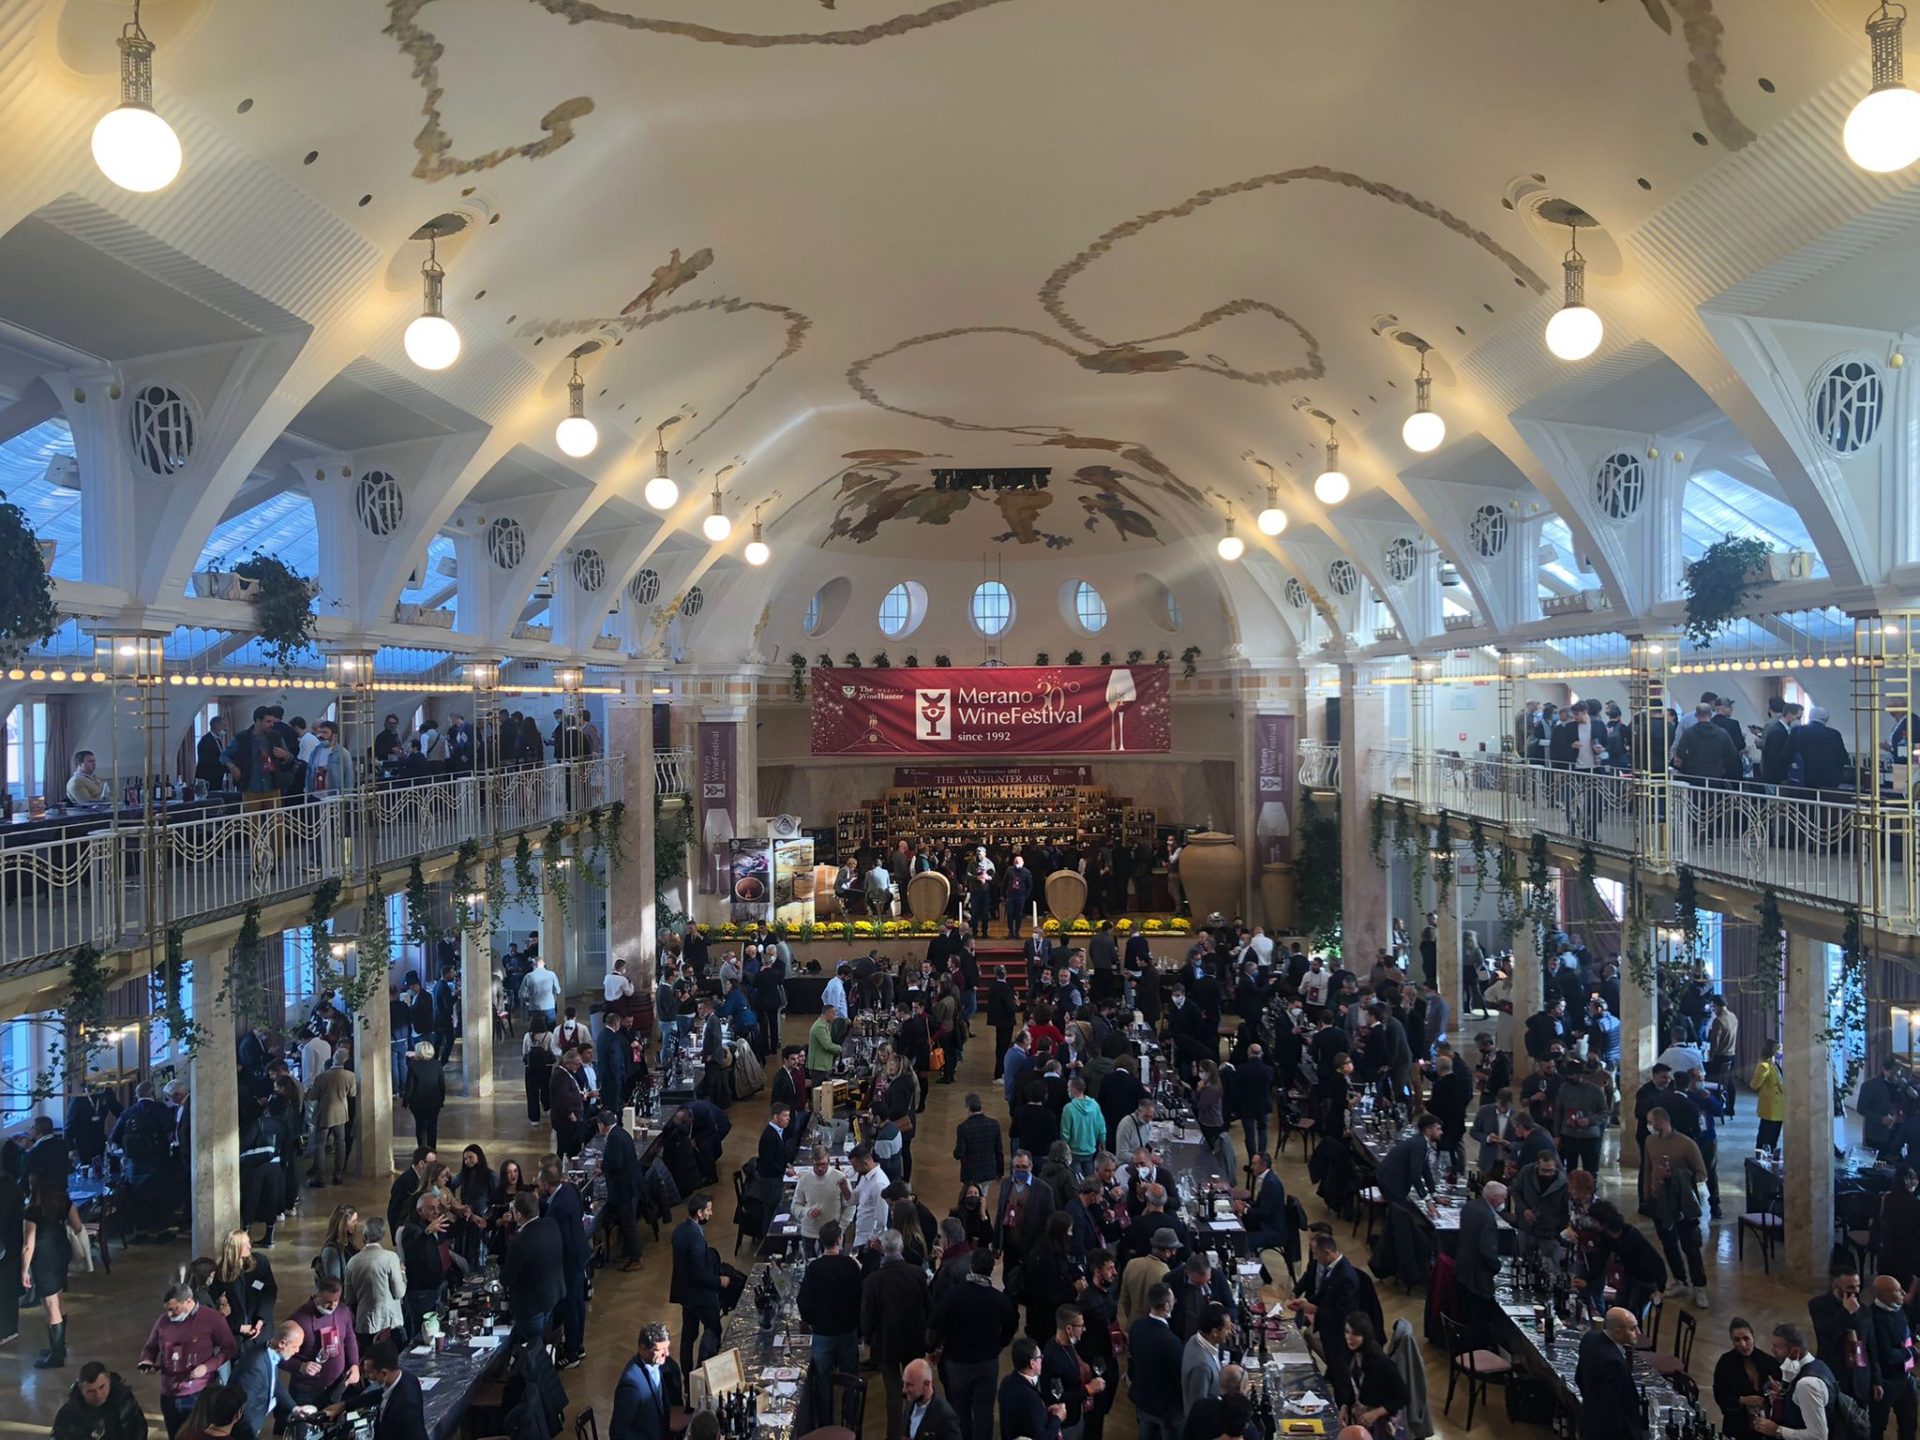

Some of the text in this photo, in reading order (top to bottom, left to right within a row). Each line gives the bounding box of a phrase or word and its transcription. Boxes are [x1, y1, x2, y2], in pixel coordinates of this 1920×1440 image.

[859, 685, 873, 693] The
[858, 692, 904, 701] WineHunter
[958, 687, 1033, 704] Merano
[958, 705, 1082, 725] WineFestival
[958, 732, 1011, 741] since 1992
[935, 774, 1051, 784] THE WINEHUNTER AREA
